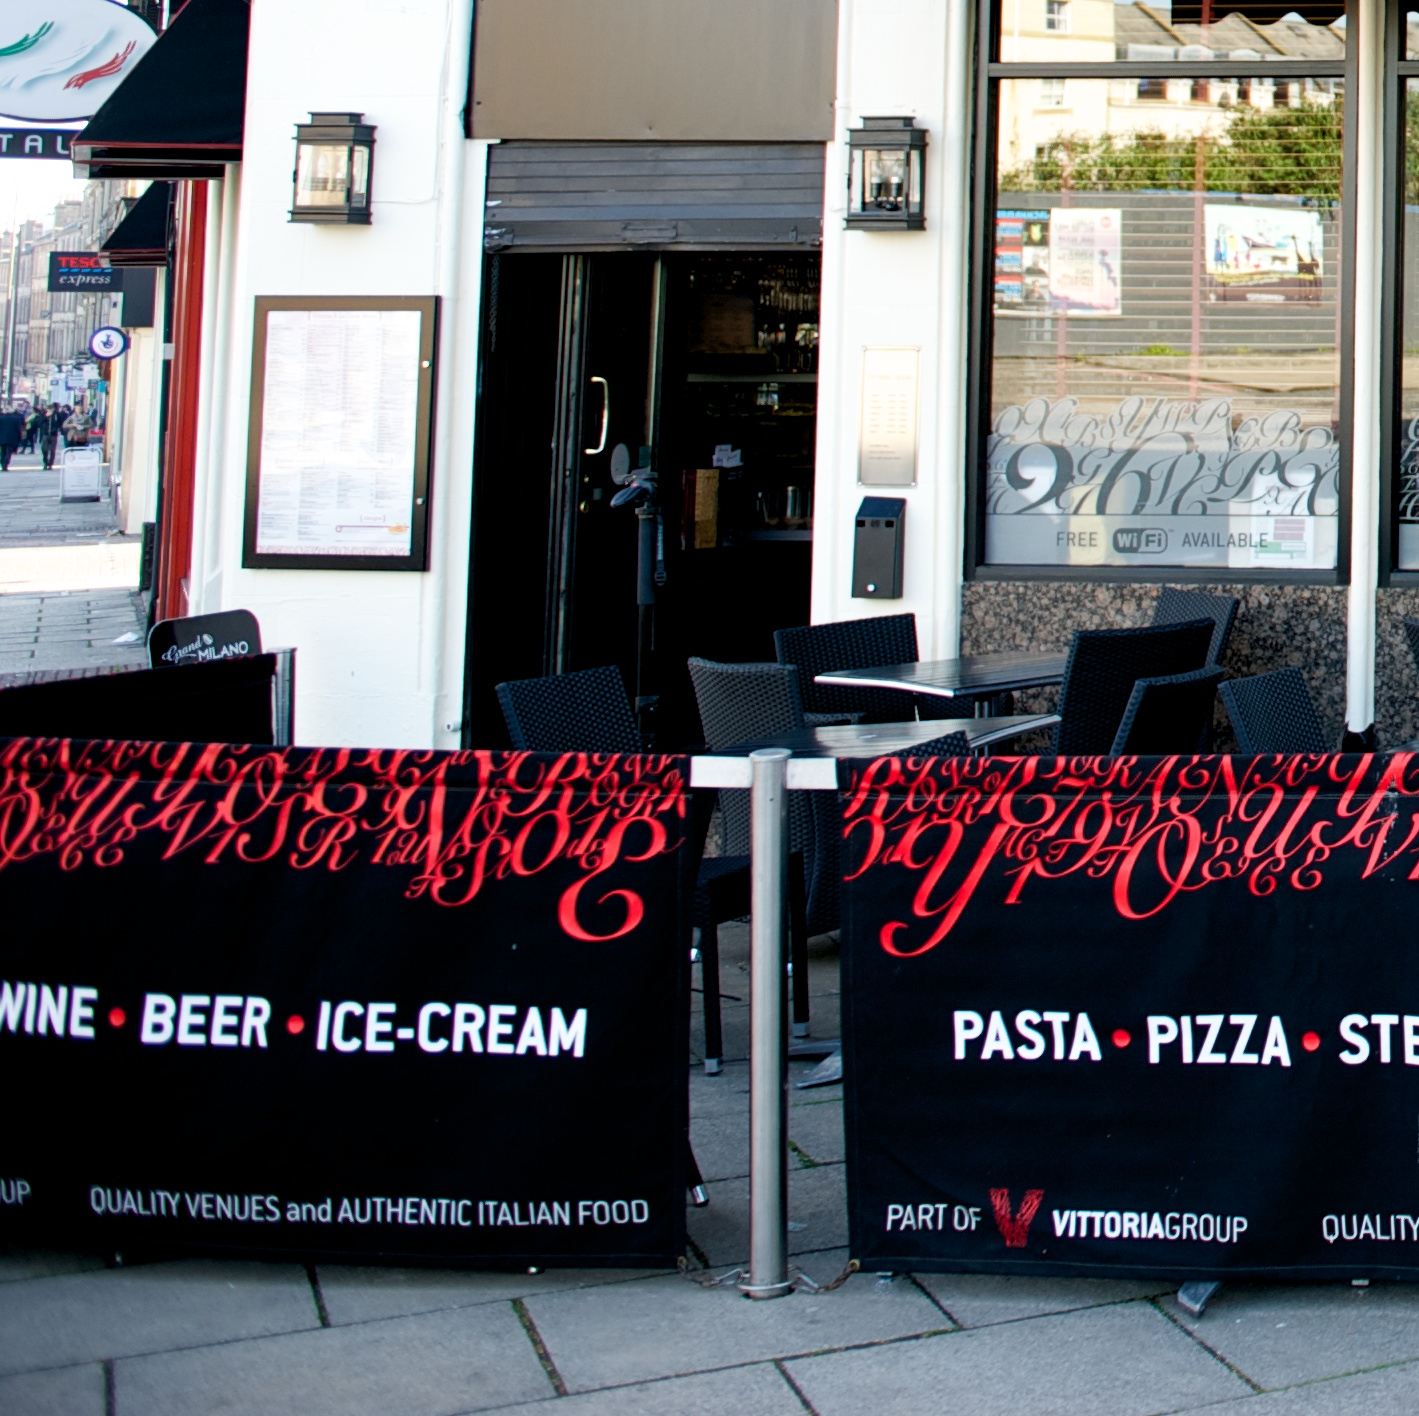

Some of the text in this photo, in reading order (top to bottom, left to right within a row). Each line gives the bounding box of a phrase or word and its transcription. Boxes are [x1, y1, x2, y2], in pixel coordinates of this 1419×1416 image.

[58, 256, 102, 268] TESC
[58, 274, 112, 286] express
[1056, 532, 1098, 547] FREE
[1182, 532, 1268, 548] AVAILABLE
[161, 634, 203, 663] Grand
[198, 640, 249, 662] MILANO
[141, 994, 271, 1047] BEER
[316, 1001, 587, 1058] ICE-CREAM
[953, 1010, 1102, 1061] PASTA
[1147, 1014, 1291, 1067] PIZZA
[90, 1187, 649, 1226] QUALITY VENUES and AUTHENTIC ITALIAN FOOD
[886, 1203, 947, 1231] PART
[953, 1205, 981, 1231] OF
[1052, 1210, 1248, 1243] VITTORIAGROUP
